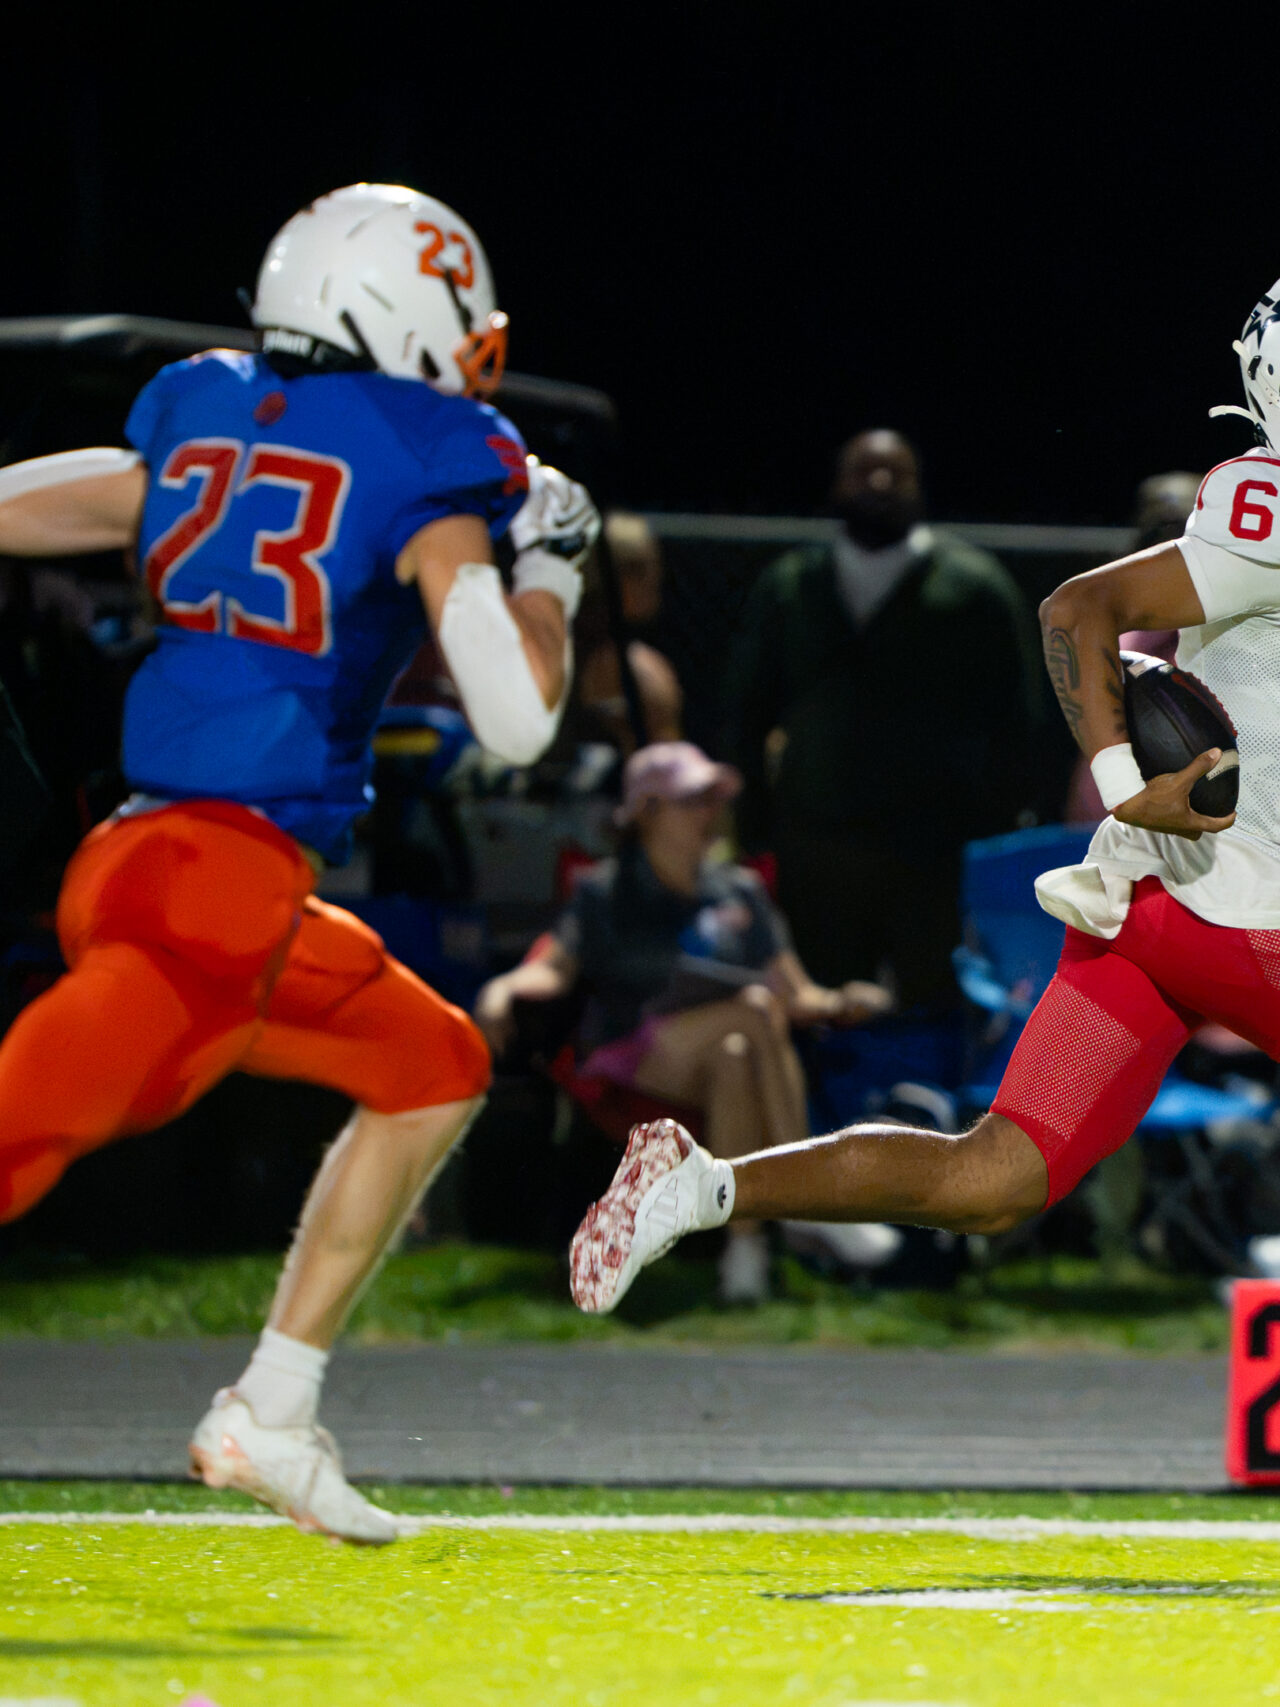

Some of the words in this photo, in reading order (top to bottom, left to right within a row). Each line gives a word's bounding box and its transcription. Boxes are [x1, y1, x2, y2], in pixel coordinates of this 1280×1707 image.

[414, 221, 475, 290] 23
[1228, 479, 1279, 542] 6
[145, 437, 352, 657] 23
